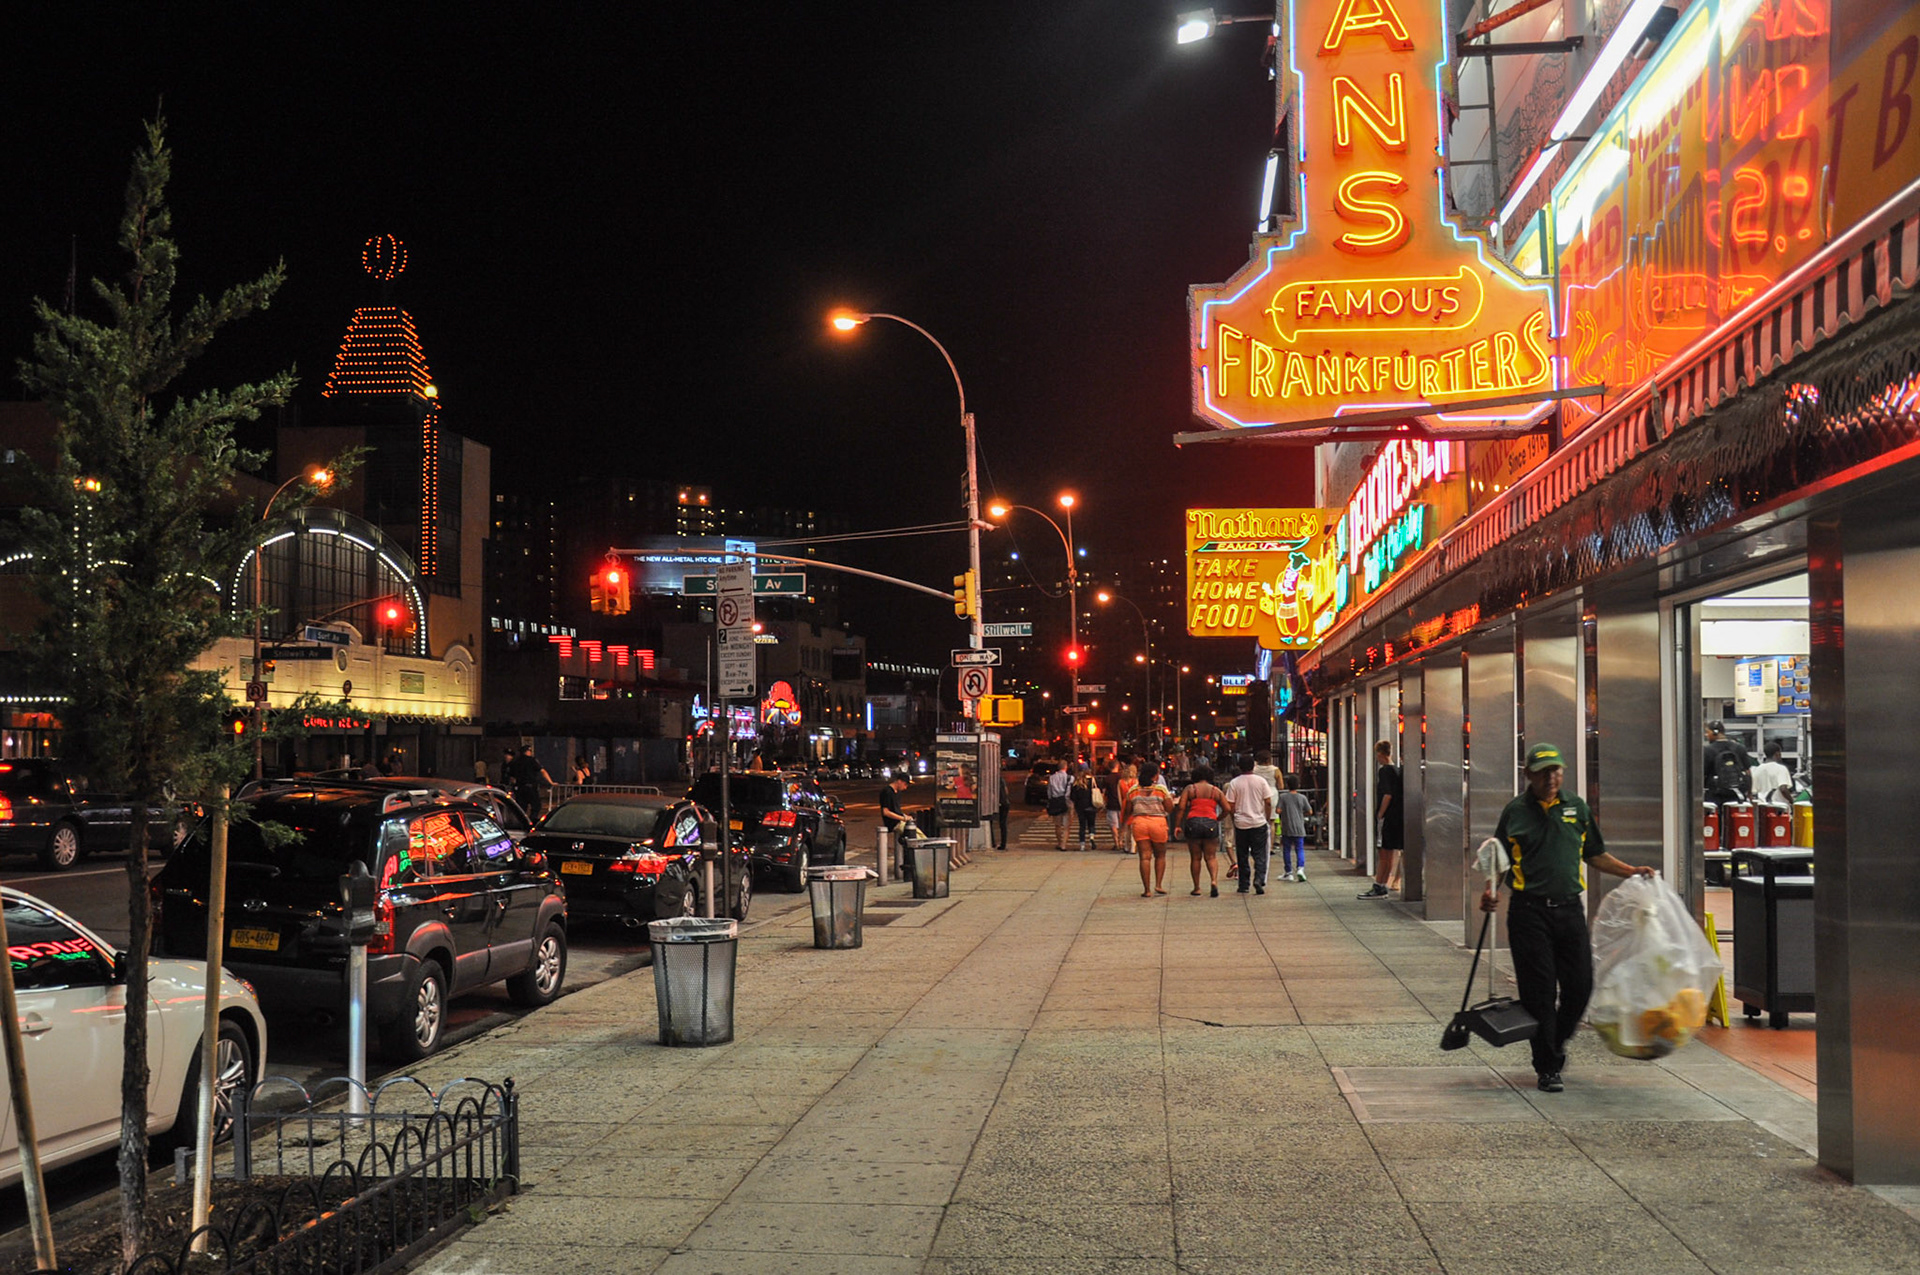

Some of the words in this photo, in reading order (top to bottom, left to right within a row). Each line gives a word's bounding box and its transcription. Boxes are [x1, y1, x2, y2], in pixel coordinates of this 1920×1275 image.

[1296, 286, 1460, 317] FAMOUS
[1217, 311, 1551, 398] FRANKFURTERS
[1189, 511, 1319, 539] Nathan's
[1216, 542, 1278, 551] FAMOUS
[1195, 558, 1259, 577] TAKE
[765, 580, 782, 589] Av
[1191, 581, 1260, 600] HOME
[1190, 603, 1257, 628] FOOD
[317, 631, 330, 639] Surf
[332, 632, 340, 640] Av
[984, 624, 1021, 635] Stillwell
[720, 630, 726, 643] 2
[959, 654, 973, 662] ONE
[1222, 686, 1247, 695] LOTTO
